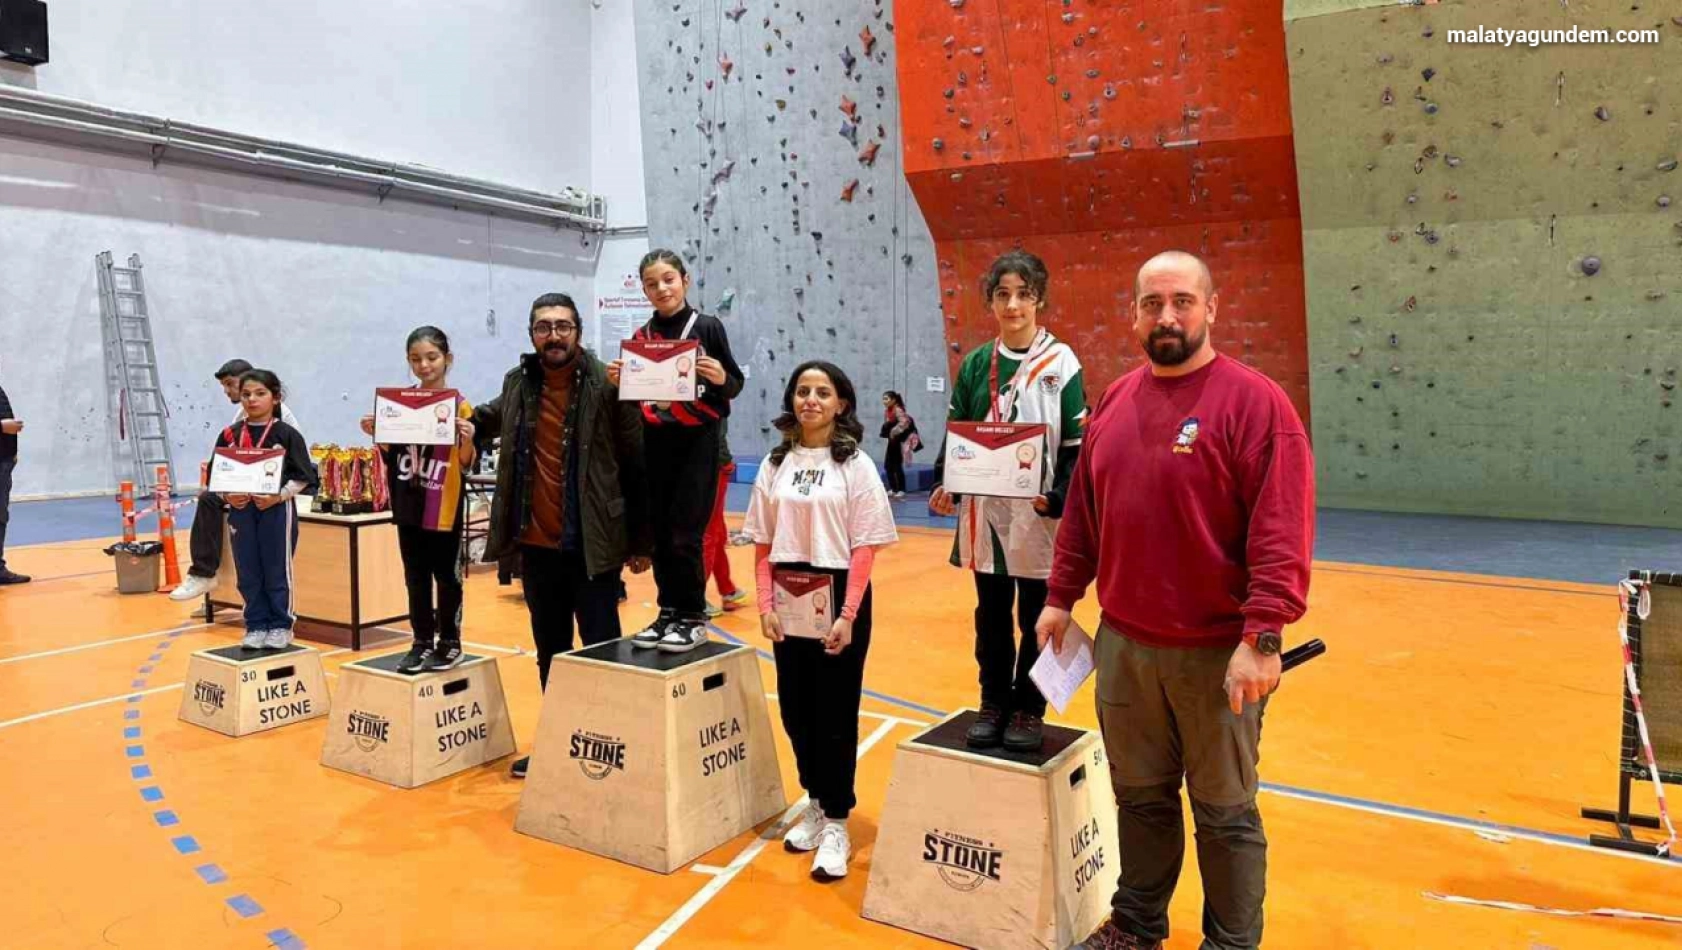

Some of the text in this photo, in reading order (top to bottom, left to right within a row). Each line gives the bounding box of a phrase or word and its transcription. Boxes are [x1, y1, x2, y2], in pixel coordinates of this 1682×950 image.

[241, 670, 257, 682] 30
[672, 682, 686, 698] 60
[194, 682, 226, 709] STONE
[257, 680, 306, 702] LIKE A
[418, 685, 434, 697] 40
[259, 699, 312, 723] STONE
[435, 701, 482, 728] LIKE A
[347, 713, 389, 743] STONE
[437, 723, 488, 752] STONE
[699, 717, 741, 749] LIKE A
[569, 734, 626, 770] STONE
[702, 742, 746, 776] STONE
[1093, 748, 1103, 766] 50
[1070, 817, 1099, 860] LIKE A
[923, 833, 1003, 882] STONE
[1074, 846, 1104, 893] STONE
